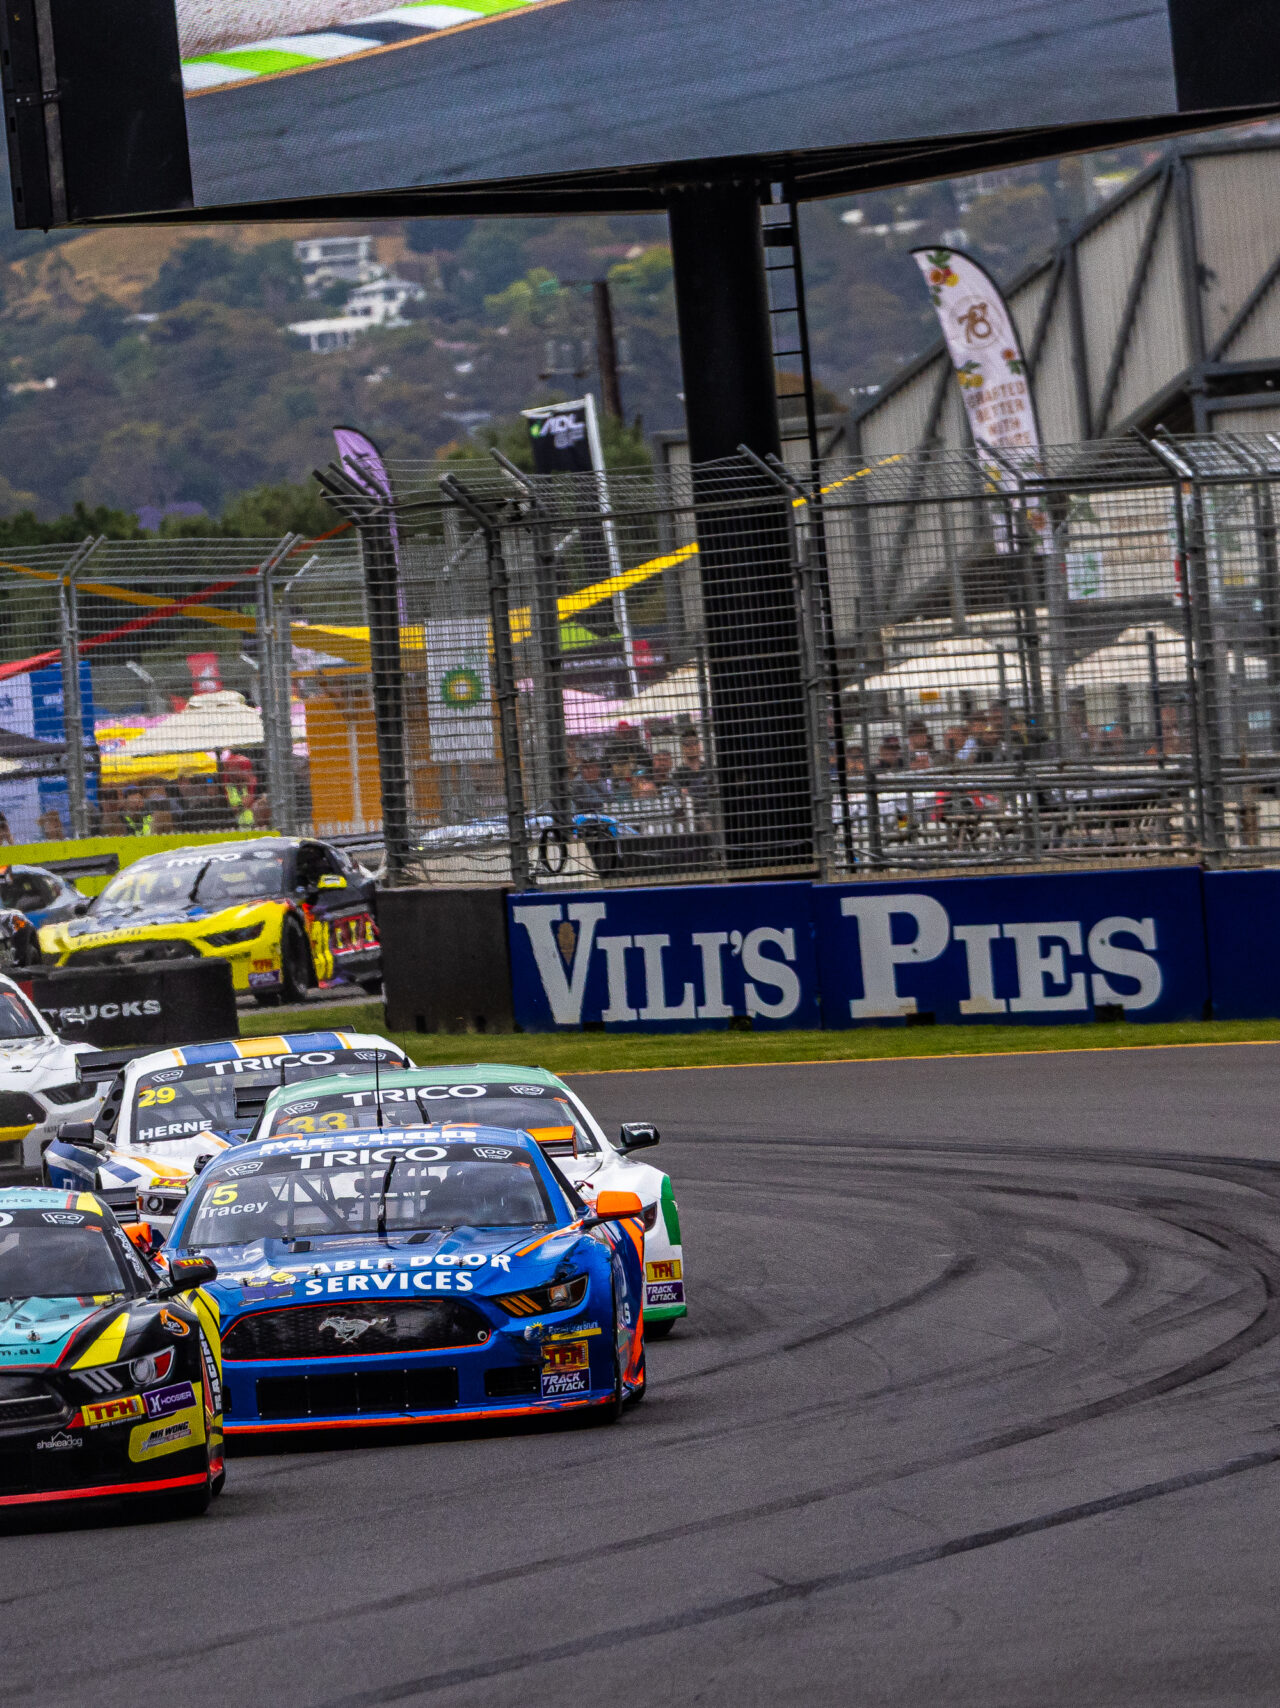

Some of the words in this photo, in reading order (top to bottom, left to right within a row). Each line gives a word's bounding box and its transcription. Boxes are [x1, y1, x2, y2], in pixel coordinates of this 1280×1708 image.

[205, 1052, 337, 1075] TRICO
[138, 1087, 176, 1107] 29
[343, 1084, 488, 1106] TRICO
[139, 1120, 213, 1140] HERNE
[287, 1112, 348, 1133] 33
[261, 1130, 478, 1151] METHOD
[290, 1146, 448, 1169] TRICO
[211, 1184, 239, 1206] 5
[198, 1200, 269, 1221] Tracey
[181, 1257, 204, 1268] TFH
[410, 1254, 512, 1273] DOOR
[651, 1262, 673, 1278] TFH
[305, 1271, 474, 1296] SERVICES
[647, 1285, 674, 1294] TRACK
[650, 1292, 678, 1302] ATTACK
[543, 1372, 580, 1386] TRACK
[546, 1381, 585, 1394] ATTACK
[160, 1391, 192, 1405] HOOSIER
[88, 1399, 135, 1420] TFH
[149, 1429, 164, 1441] MR
[164, 1421, 190, 1436] WONG
[36, 1434, 83, 1449] shakeadog
